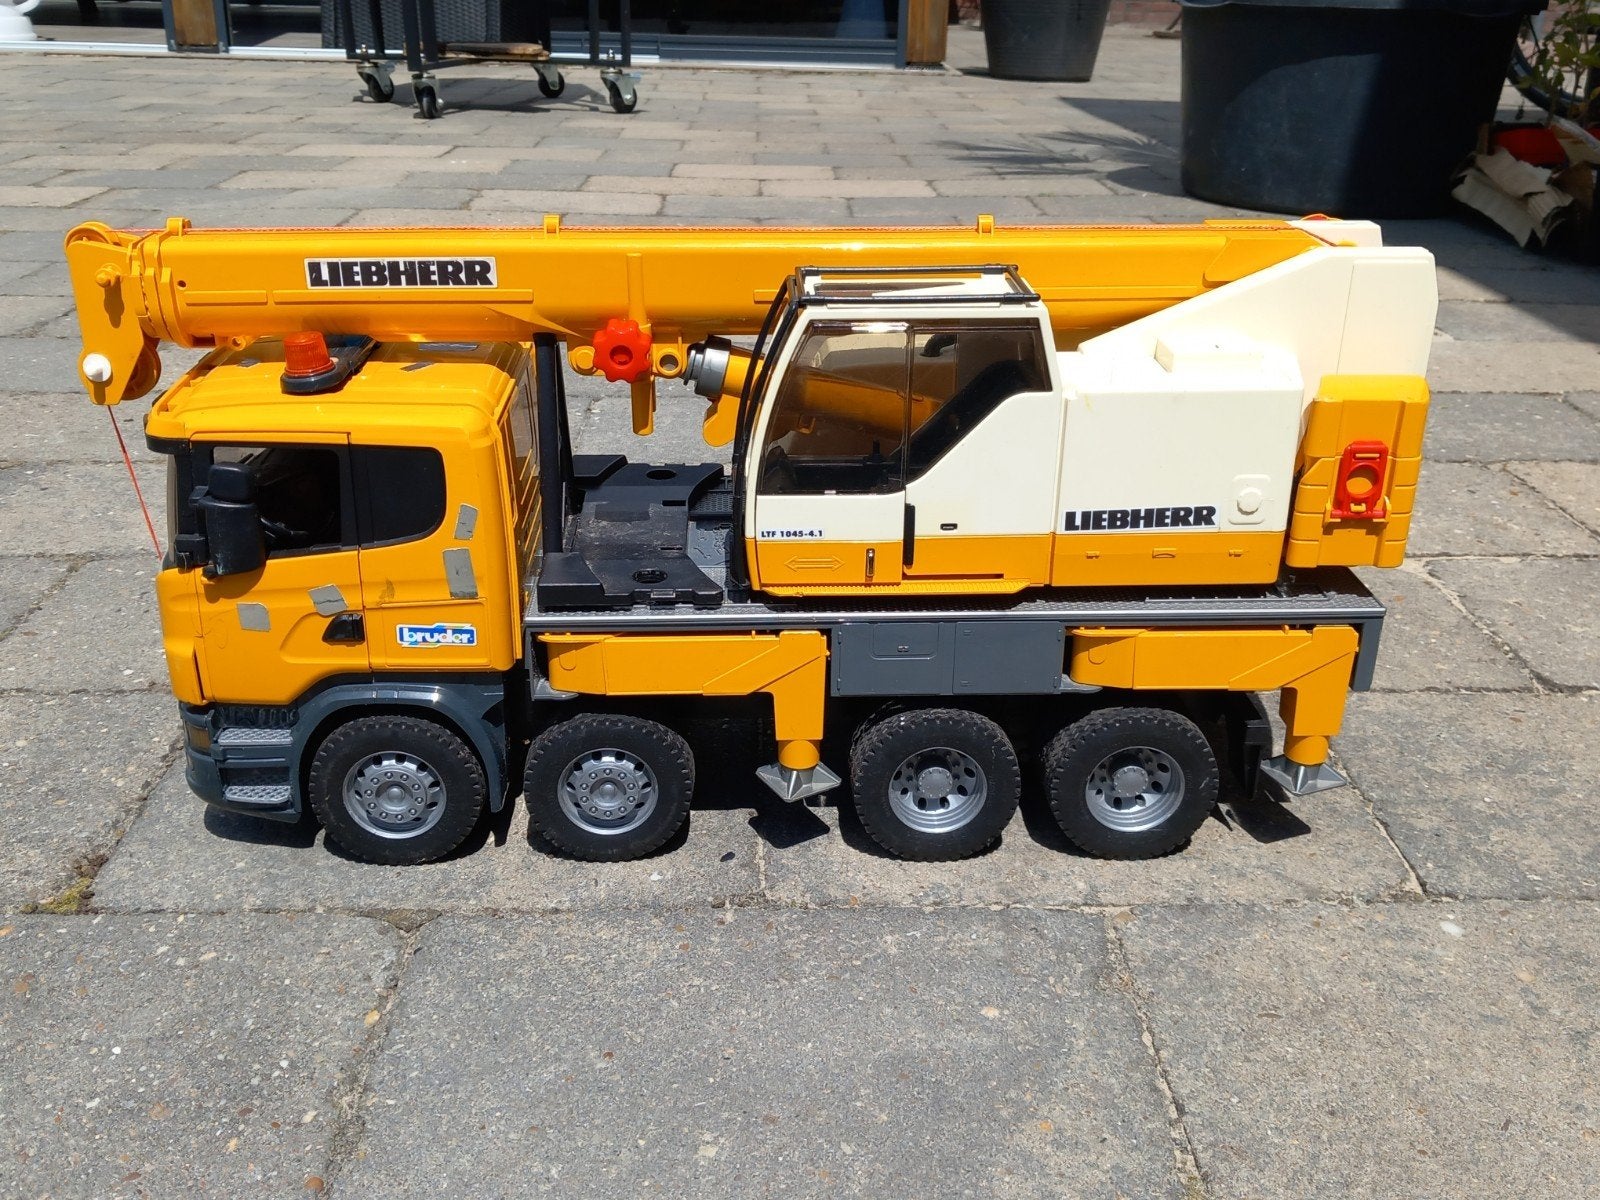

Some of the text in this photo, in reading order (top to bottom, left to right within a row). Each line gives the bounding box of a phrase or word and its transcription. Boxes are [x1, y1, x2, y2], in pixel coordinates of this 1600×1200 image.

[307, 260, 495, 288] LIEBHERR
[1064, 505, 1217, 532] LIEBHERR
[761, 529, 823, 538] LTF 1045-4.1
[402, 627, 472, 644] bruder
